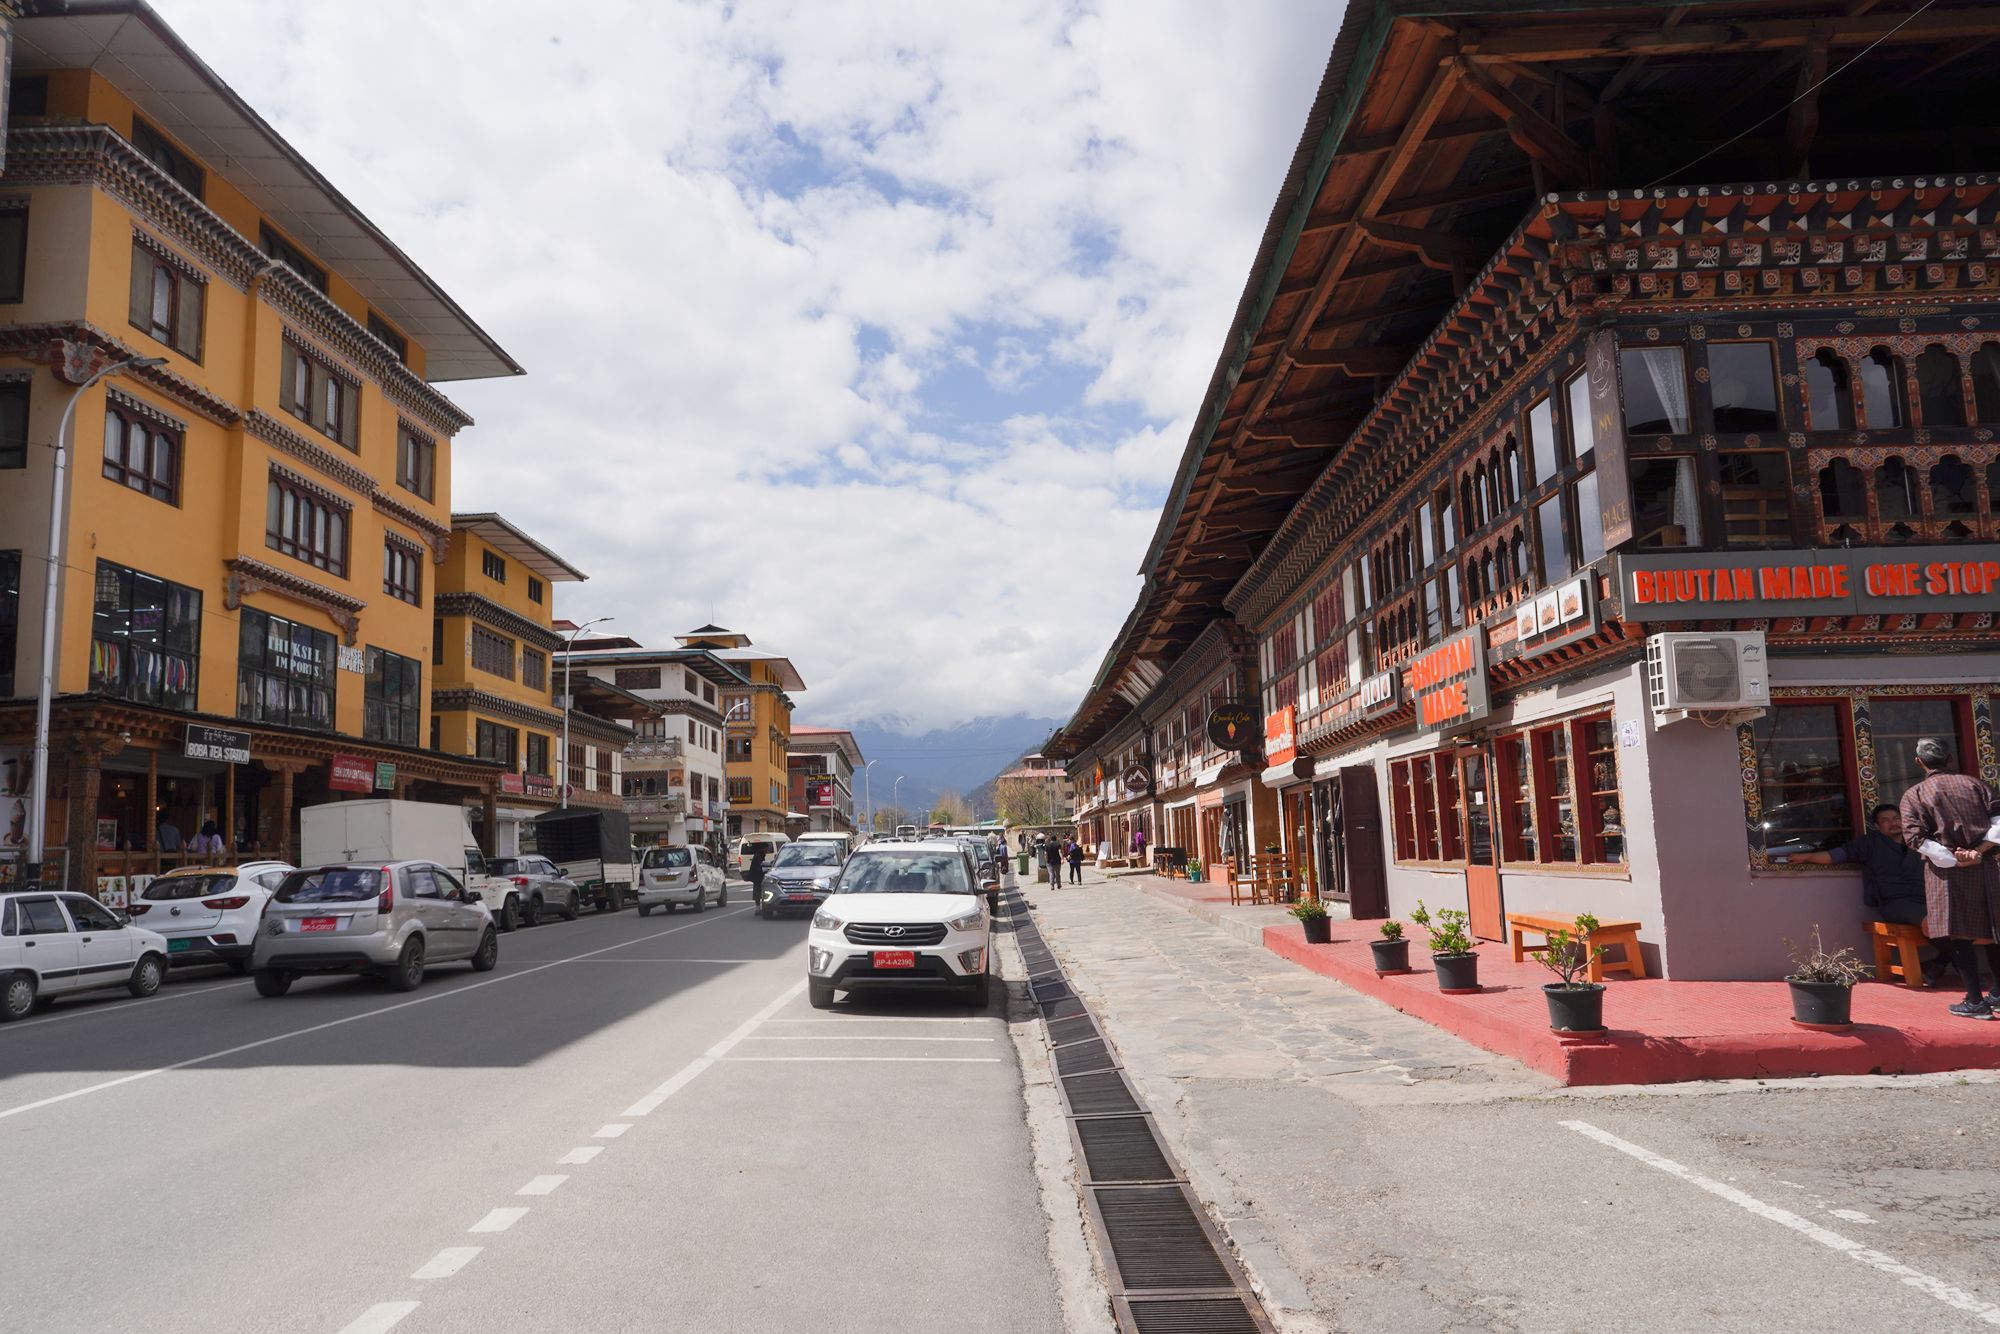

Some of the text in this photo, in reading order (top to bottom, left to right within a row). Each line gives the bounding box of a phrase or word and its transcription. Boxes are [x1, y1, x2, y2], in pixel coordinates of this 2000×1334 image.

[1602, 502, 1628, 532] PLACE
[1633, 561, 2000, 603] BHUTAN MADE ONE STOP
[337, 656, 364, 674] IMPORTS
[338, 644, 364, 662] THUKSEL
[1412, 635, 1474, 692] BHUTAN
[1422, 681, 1469, 726] MADE
[187, 742, 249, 762] BOBA TEA STATION
